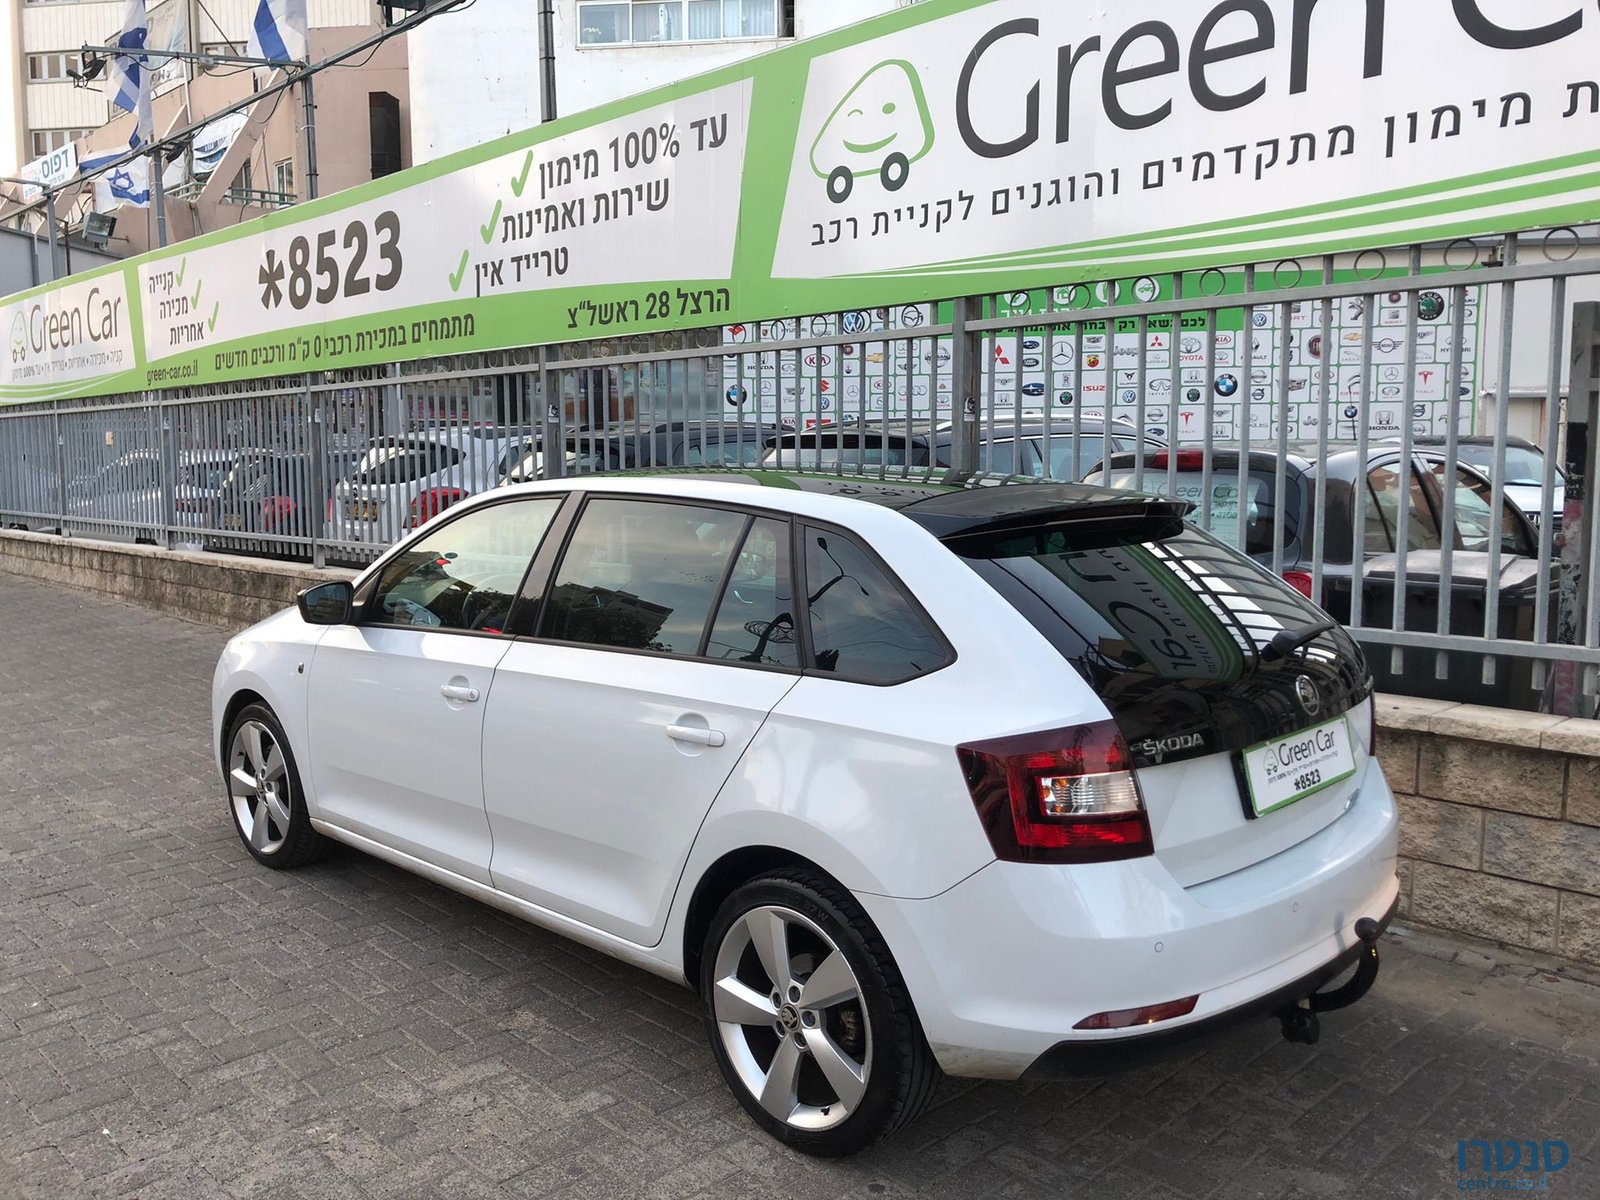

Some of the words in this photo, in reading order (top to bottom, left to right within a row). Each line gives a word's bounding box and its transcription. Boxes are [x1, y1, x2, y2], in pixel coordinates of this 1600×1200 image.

[956, 0, 1386, 159] Green
[690, 113, 727, 151] עד
[1384, 91, 1532, 158] מימון
[608, 122, 680, 172] 100%
[1143, 124, 1355, 190] מתקדמים
[539, 149, 599, 200] מימון
[592, 178, 669, 223] שירות
[991, 167, 1119, 216] והוגנים
[501, 198, 585, 243] ואמינות
[872, 189, 974, 236] לקניית
[811, 216, 858, 246] רכב
[474, 259, 504, 298] אין
[511, 246, 569, 283] טרייד
[149, 271, 174, 296] קנייה
[159, 296, 188, 320] מכירה
[645, 290, 670, 320] 28
[676, 287, 730, 316] הרצל
[30, 303, 83, 354] Green
[87, 287, 121, 342] Car
[169, 321, 204, 346] אחריות
[411, 313, 475, 344] מתמחים
[313, 334, 322, 358] 0
[324, 333, 352, 356] רכבי
[355, 323, 407, 352] במכירת
[214, 350, 248, 371] חדשים
[251, 342, 285, 366] ורכבים
[808, 356, 828, 365] KA
[146, 360, 199, 386] green-car.co.il
[1142, 733, 1205, 757] ŠKODA
[1278, 739, 1316, 767] Green
[1315, 729, 1335, 752] Car
